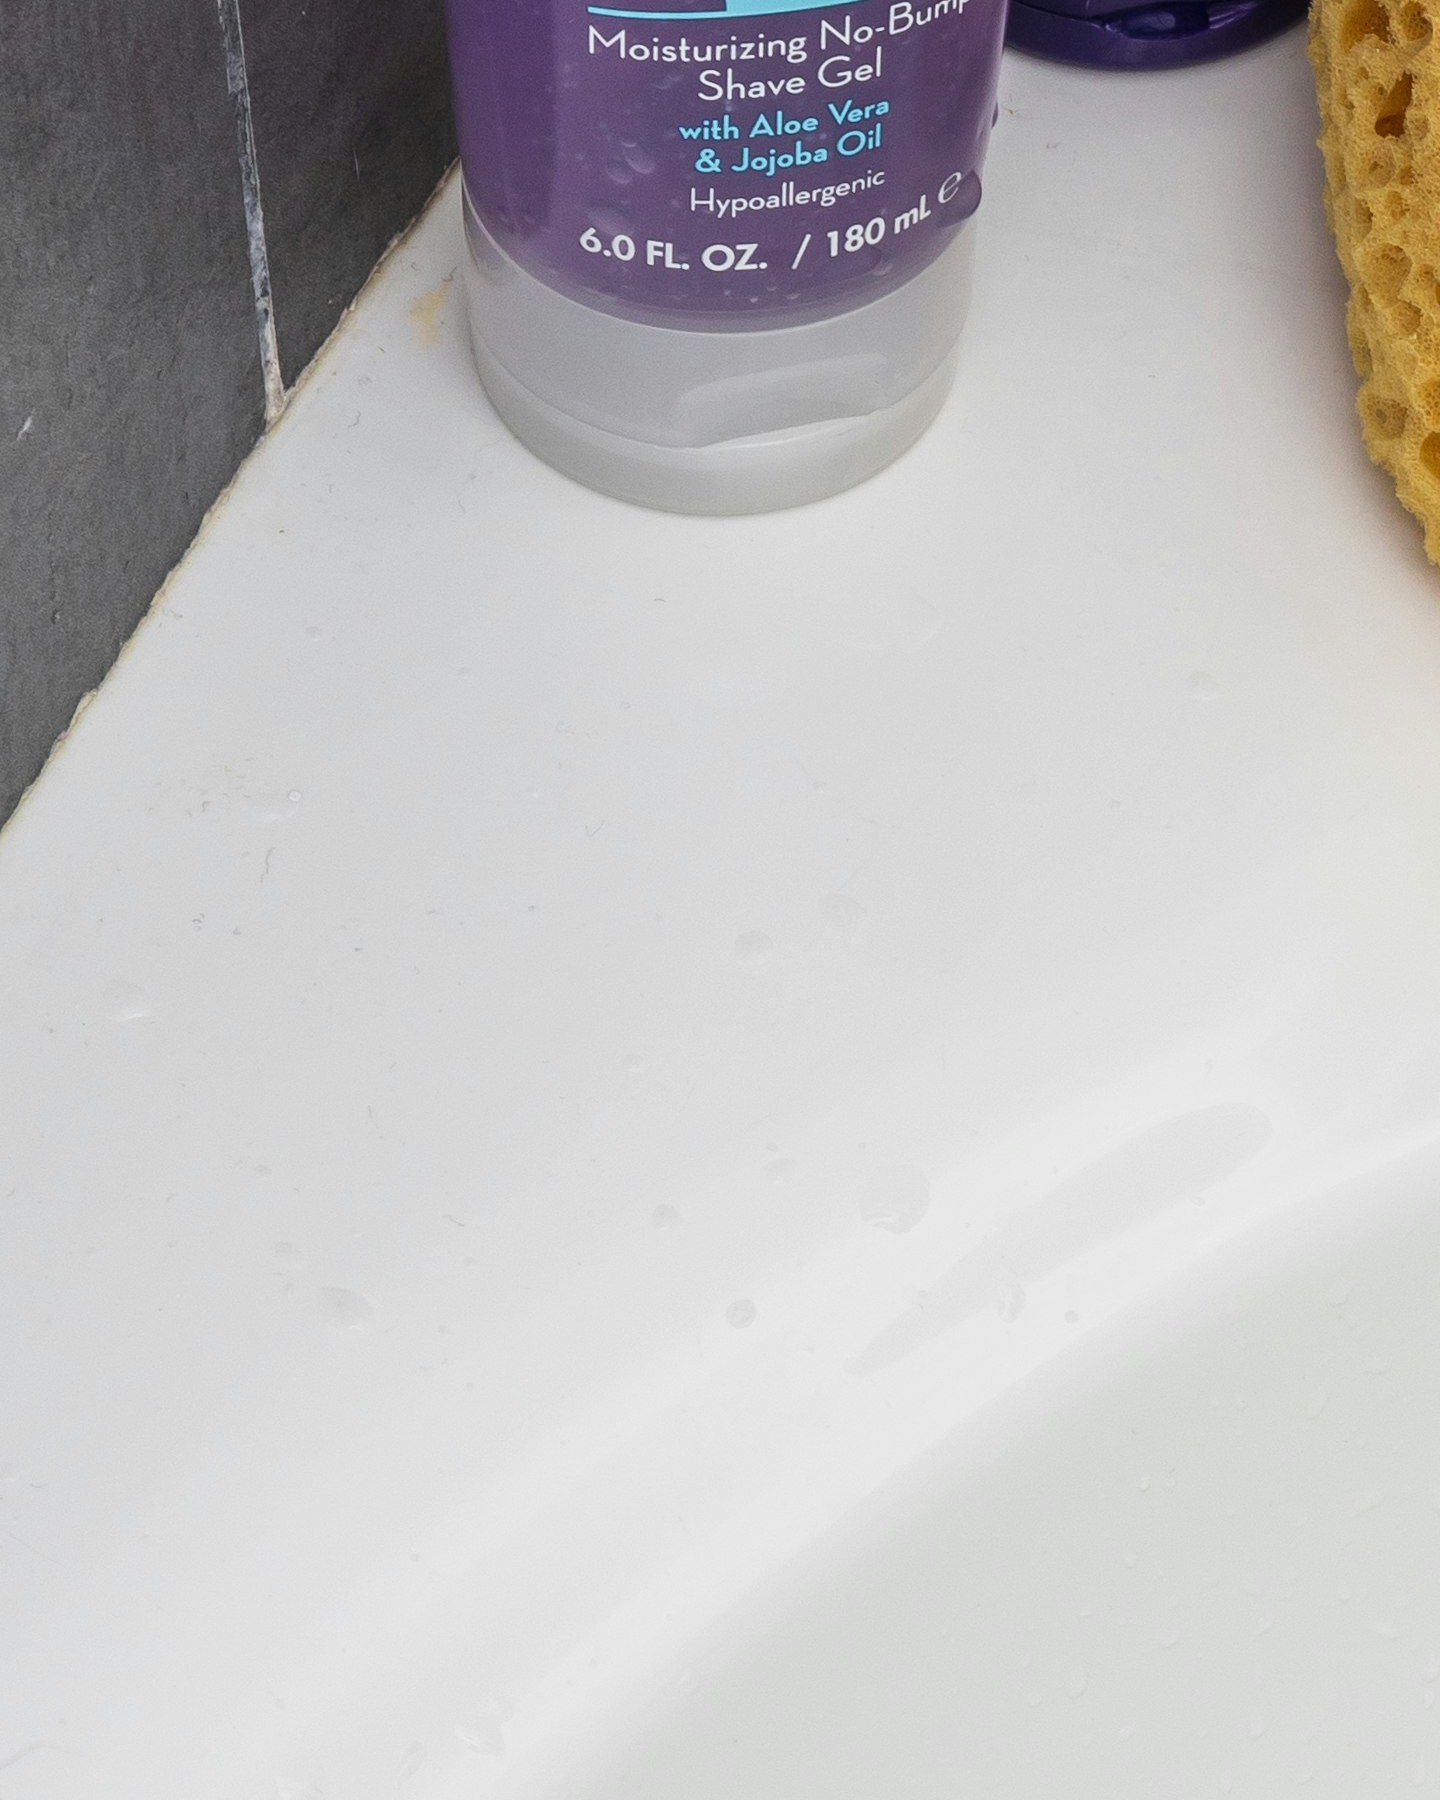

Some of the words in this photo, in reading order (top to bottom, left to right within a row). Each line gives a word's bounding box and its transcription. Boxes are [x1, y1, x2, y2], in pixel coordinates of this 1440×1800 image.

[587, 25, 807, 62] Moisturizing
[697, 68, 806, 101] Shave
[816, 47, 883, 90] Gel
[678, 116, 740, 142] with
[748, 112, 818, 138] Aloe
[827, 98, 890, 128] Vera
[694, 149, 721, 174] &
[731, 144, 829, 178] Jojoba
[836, 123, 883, 158] Oil
[689, 168, 886, 218] Hypoallergenic
[579, 227, 636, 263] 6.0
[646, 240, 690, 271] FL.
[702, 243, 768, 271] OZ.
[791, 234, 811, 270] /
[826, 216, 885, 260] 180
[892, 194, 933, 235] mL
